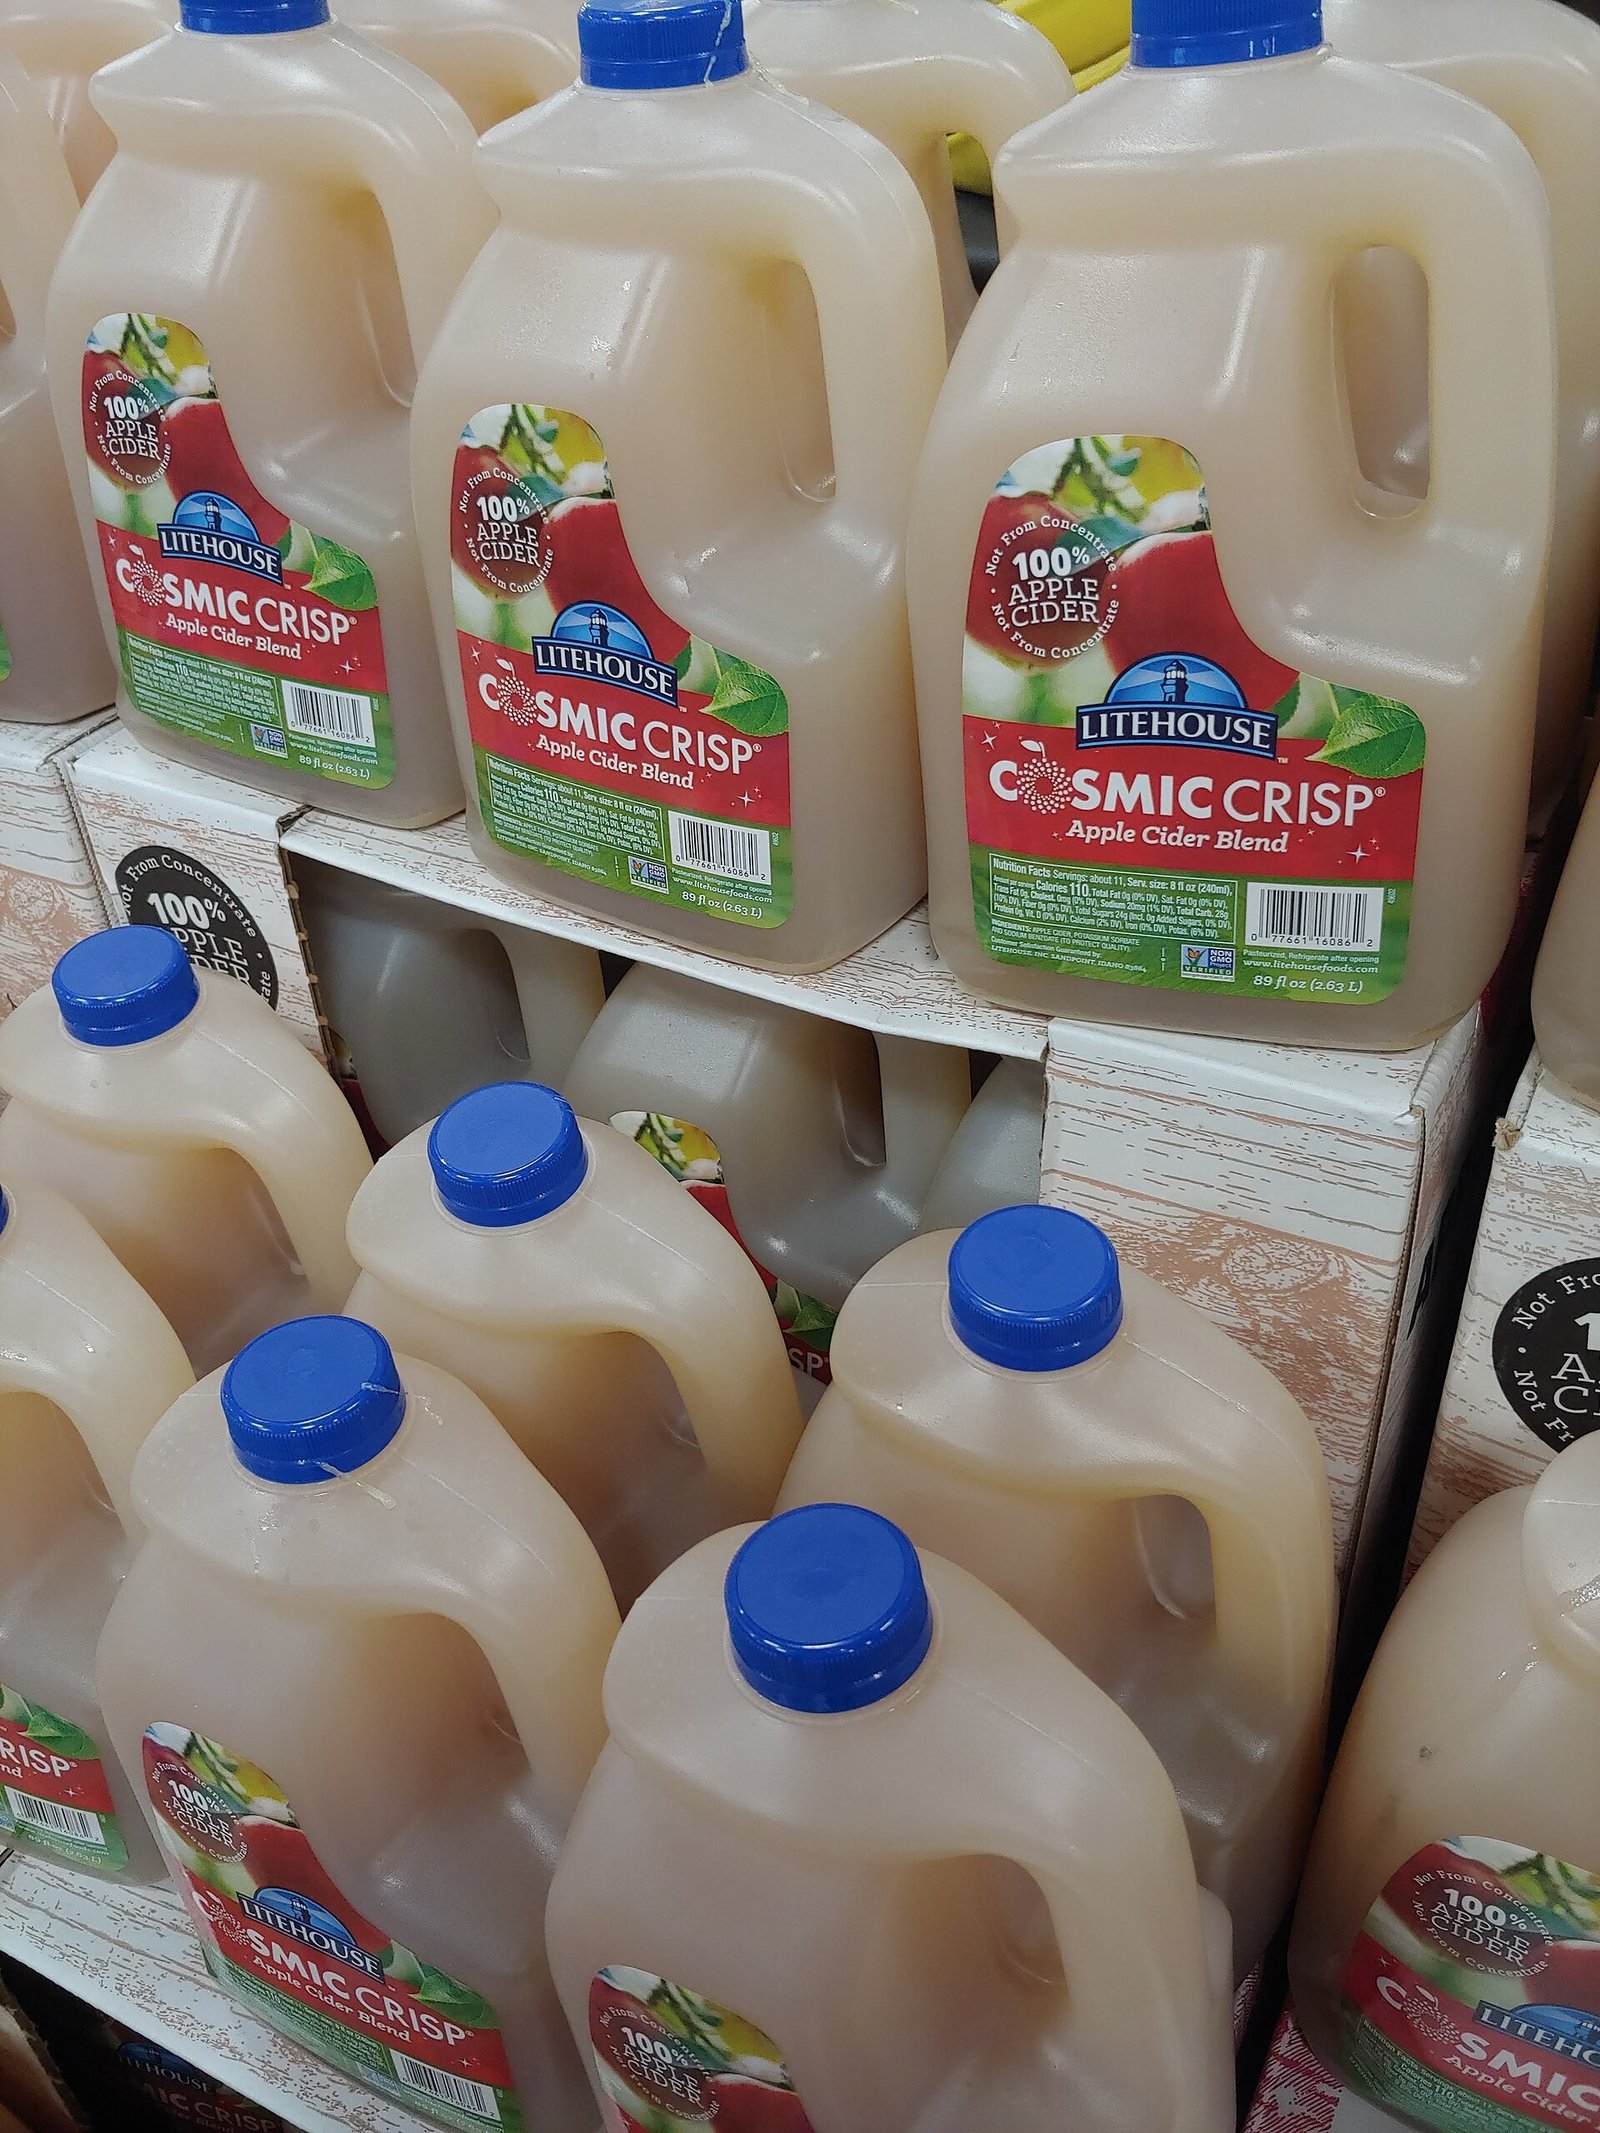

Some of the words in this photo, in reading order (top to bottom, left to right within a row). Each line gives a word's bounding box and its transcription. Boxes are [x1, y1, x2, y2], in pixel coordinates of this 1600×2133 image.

[90, 391, 98, 412] Not
[95, 372, 115, 390] From
[116, 370, 166, 422] Concentrate
[103, 396, 149, 420] 100%
[106, 420, 158, 443] APPLE
[109, 438, 161, 461] CIDER
[97, 434, 110, 457] Not
[111, 458, 133, 482] From
[135, 443, 171, 485] Concentrate
[459, 490, 471, 514] Not
[467, 470, 491, 490] From
[493, 467, 550, 525] Concentrate
[477, 496, 530, 522] 100%
[161, 531, 279, 577] LITEHOUSE
[477, 522, 539, 548] APPLE
[985, 548, 1004, 578] Not
[1001, 520, 1037, 546] From
[1040, 515, 1117, 572] Concentrate
[466, 537, 480, 563] Not
[481, 563, 507, 590] From
[509, 549, 554, 593] Concentrate
[480, 542, 541, 568] CIDER
[1012, 546, 1090, 580] 100%
[1008, 578, 1100, 606] APPLE
[992, 603, 1011, 632] Not
[1010, 631, 1046, 657] From
[1050, 600, 1119, 658] Concentrate
[1011, 600, 1100, 627] CIDER
[166, 613, 207, 637] Apple
[210, 625, 252, 648] Cider
[255, 636, 302, 660] Blend
[535, 645, 674, 698] LITEHOUSE
[1081, 712, 1271, 752] LITEHOUSE
[299, 755, 312, 765] 89
[312, 756, 321, 769] fl
[321, 760, 334, 771] oz
[335, 762, 358, 778] (2.63
[358, 769, 370, 781] L)
[536, 735, 586, 762] Apple
[588, 749, 637, 776] Cider
[640, 762, 695, 790] Blend
[1066, 820, 1136, 846] Apple
[1142, 824, 1210, 851] Cider
[1215, 830, 1290, 854] Blend
[690, 858, 717, 872] 77661
[721, 866, 749, 879] 16086
[760, 873, 767, 882] 2
[993, 858, 1027, 874] Nutrition
[1028, 866, 1051, 878] Facts
[1053, 869, 1088, 883] Servings:
[1090, 875, 1112, 885] about
[1114, 876, 1126, 888] 11,
[1127, 877, 1148, 888] Serv.
[1150, 880, 1168, 890] size:
[1186, 884, 1197, 893] oz
[1198, 883, 1233, 897] (240ml),
[1036, 880, 1068, 894] Calories
[125, 856, 160, 881] From
[161, 855, 256, 938] Concentrate
[672, 876, 773, 904] www.litehousefoods.com
[682, 891, 697, 902] 89
[697, 893, 707, 906] fl
[707, 900, 721, 909] oz
[722, 900, 749, 917] (2.63
[750, 907, 763, 920] L)
[147, 893, 226, 930] 100%
[170, 927, 249, 966] PPLE
[1209, 949, 1232, 959] NON
[1251, 933, 1258, 943] 0
[1271, 934, 1308, 948] 77661
[1314, 937, 1352, 949] 16086
[1366, 939, 1374, 949] 2
[1184, 965, 1232, 978] VERIFIED
[1209, 956, 1232, 966] GMO
[1243, 960, 1379, 975] www.litehousefoods.com
[1254, 976, 1273, 987] 89
[1273, 976, 1287, 991] fl
[1289, 980, 1307, 990] oz
[1310, 979, 1346, 994] (2.63
[1348, 981, 1364, 995] L)
[1511, 1292, 1556, 1330] Not
[1513, 1371, 1546, 1412] Not
[168, 1780, 221, 1811] 100%
[171, 1796, 233, 1836] APPLE
[176, 1811, 238, 1851] CIDER
[1413, 1872, 1436, 1887] Not
[1435, 1869, 1477, 1885] From
[1482, 1881, 1553, 1948] Concentrate
[1443, 1888, 1528, 1932] 100%
[241, 1899, 382, 1978] LITEHOUSE
[1411, 1899, 1428, 1924] Not
[1426, 1927, 1460, 1958] From
[1465, 1957, 1548, 1979] Concentrate
[1430, 1902, 1530, 1957] APPLE
[1430, 1915, 1524, 1968] CIDER
[252, 1956, 302, 1989] Apple
[304, 1986, 354, 2014] Cider
[357, 2010, 413, 2043] Blend
[608, 2006, 638, 2019] From
[620, 2026, 689, 2068] 100%
[623, 2043, 702, 2096] APPLE
[627, 2059, 705, 2109] CIDER
[1442, 2054, 1516, 2094] Apple
[1521, 2091, 1592, 2124] Cider
